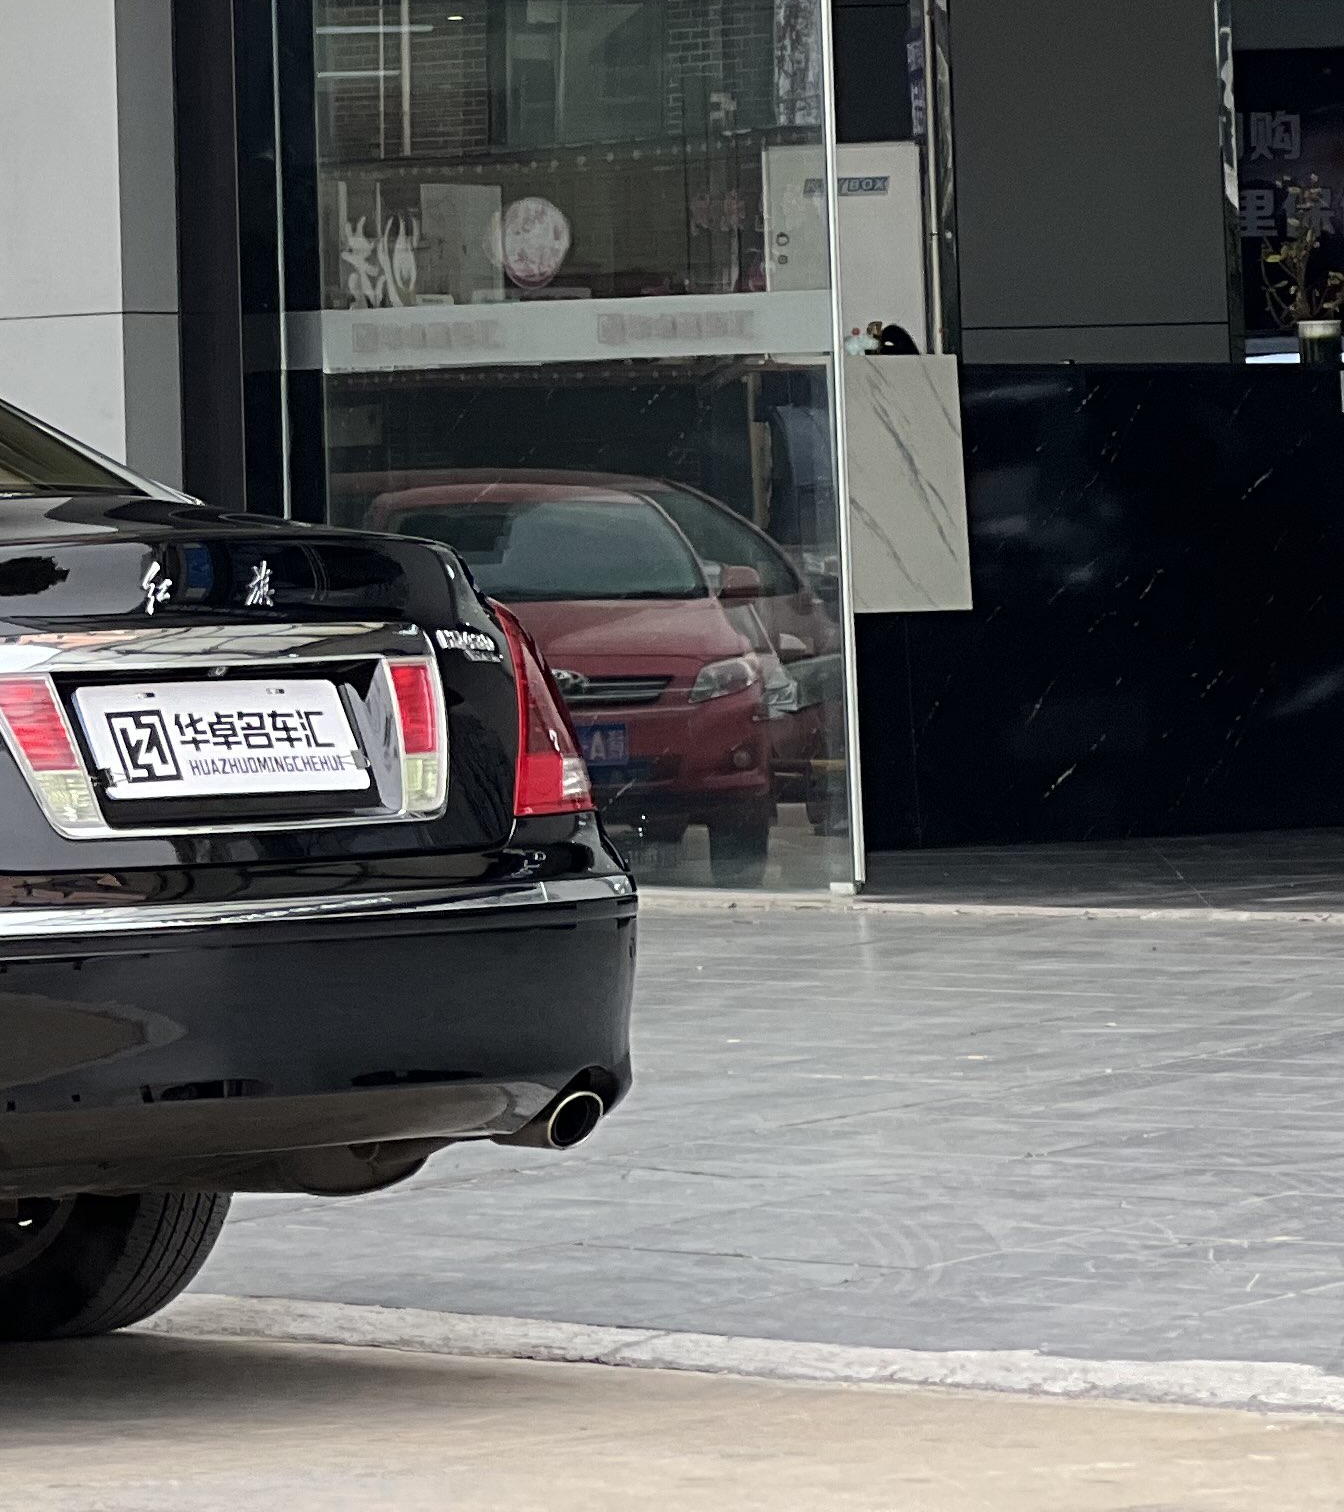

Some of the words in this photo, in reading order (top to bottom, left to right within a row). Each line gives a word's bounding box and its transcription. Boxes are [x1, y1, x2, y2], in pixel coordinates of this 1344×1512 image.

[174, 710, 335, 752] 华卓名车汇
[189, 754, 346, 778] HUAZHUOMINGCHEHUI
